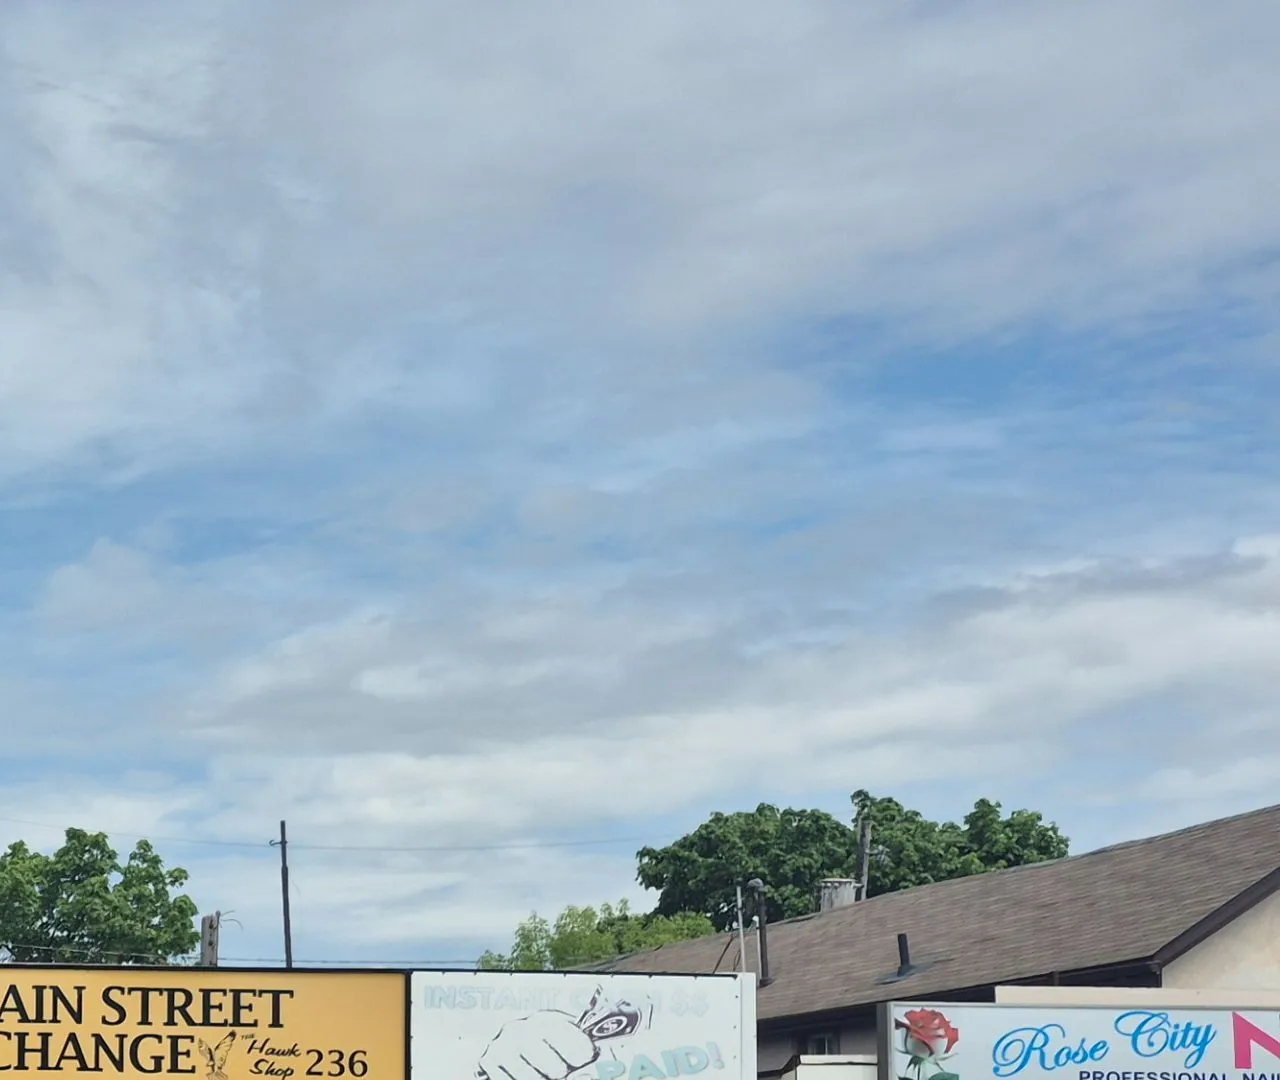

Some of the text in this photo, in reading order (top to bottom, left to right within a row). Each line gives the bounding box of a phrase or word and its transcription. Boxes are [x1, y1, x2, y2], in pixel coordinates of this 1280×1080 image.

[101, 985, 294, 1028] STREET
[247, 1037, 301, 1057] Hawk
[992, 1023, 1109, 1077] Rose
[1114, 1010, 1217, 1069] City
[305, 1049, 368, 1078] 236
